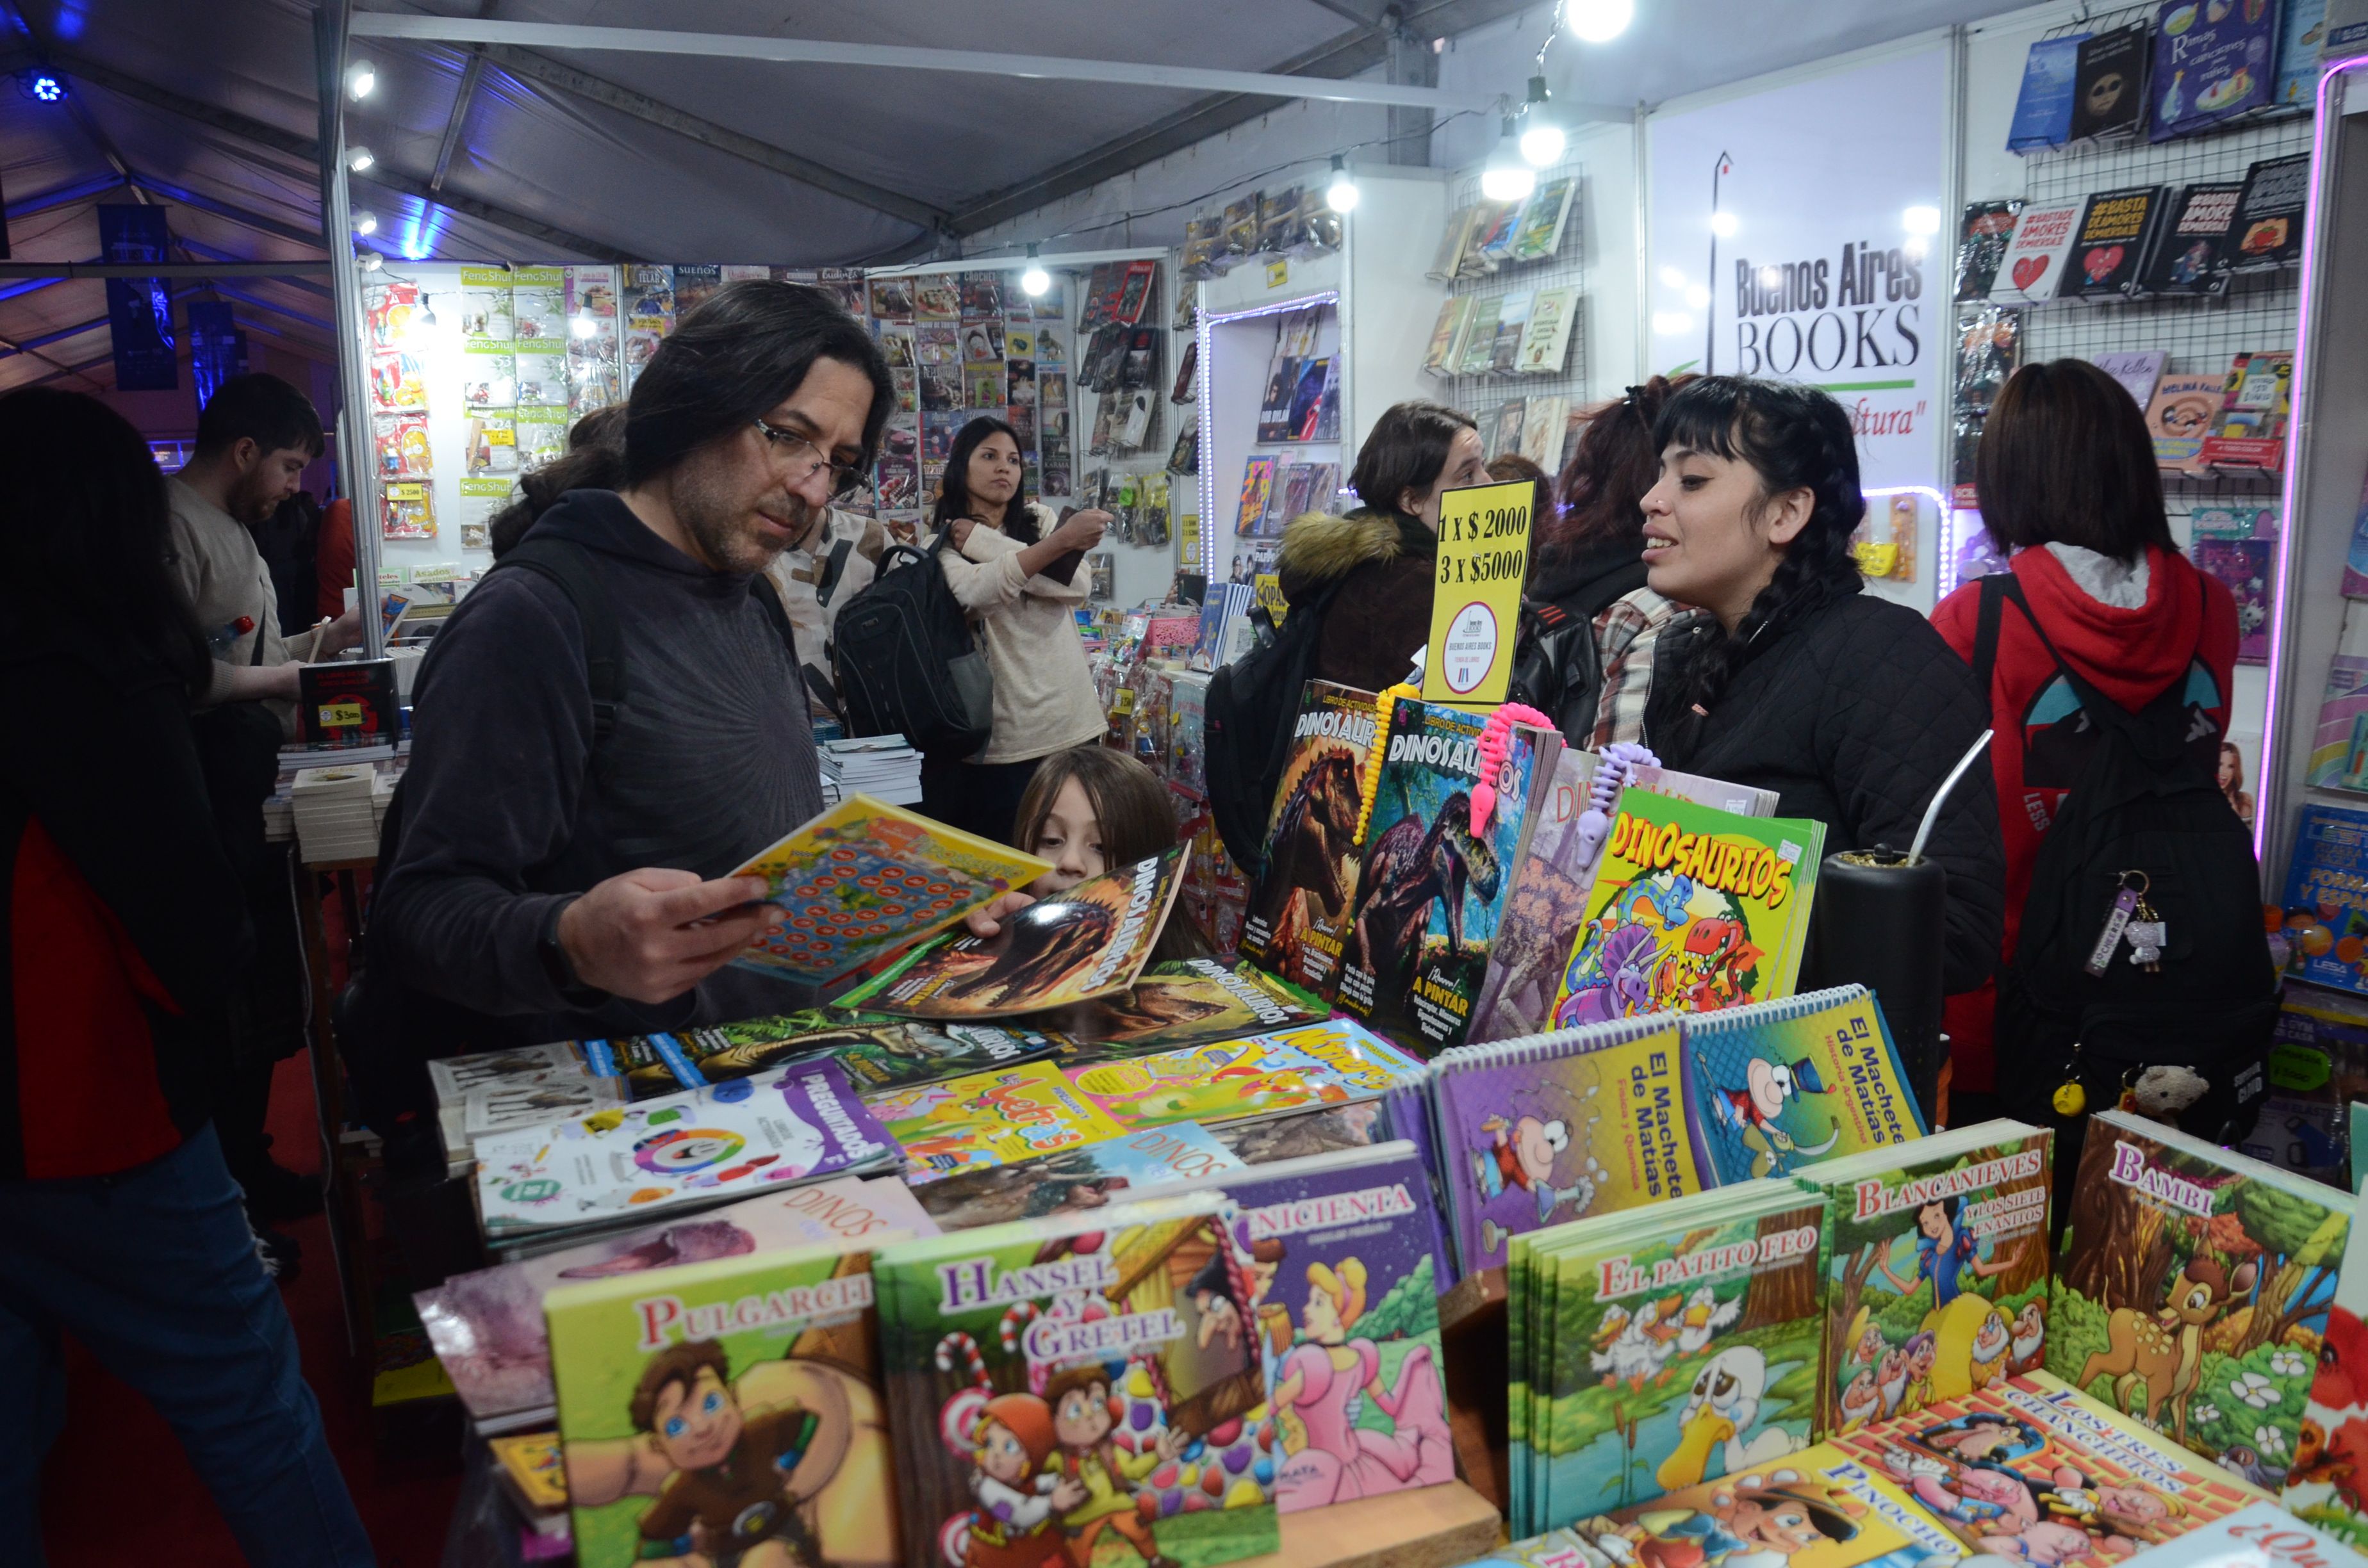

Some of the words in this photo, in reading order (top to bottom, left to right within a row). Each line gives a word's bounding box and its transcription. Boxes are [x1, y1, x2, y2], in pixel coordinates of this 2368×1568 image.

[2020, 222, 2071, 238] AMORES
[463, 271, 488, 281] Feng
[489, 271, 511, 281] Shui
[514, 272, 539, 281] Feng
[540, 272, 563, 281] Shui
[678, 265, 717, 275] SUEÑOS
[964, 272, 996, 282] CROCHET
[1736, 257, 1829, 318] Buenos
[1838, 241, 1921, 306] Aires
[518, 340, 542, 348] Feng
[543, 340, 564, 348] Shui
[1738, 304, 1920, 375] BOOKS
[463, 482, 486, 491] Feng
[1439, 514, 1447, 543] 1
[1453, 516, 1463, 543] x
[1468, 511, 1479, 543] $
[1484, 505, 1527, 539] 2000
[1440, 555, 1451, 584] 3
[1456, 558, 1466, 584] x
[2023, 792, 2051, 831] LESS
[1609, 811, 1793, 910] DINOSAURIOS
[1080, 856, 1158, 993] DINOSAURIOS
[1299, 927, 1308, 942] A
[1310, 930, 1344, 958] PINTAR
[1187, 958, 1290, 1025] DINOSAURIOS
[1413, 976, 1422, 993] A
[1424, 980, 1468, 1017] PINTAR
[1631, 1065, 1649, 1097] de
[1649, 1050, 1668, 1077] El
[1836, 1028, 1854, 1057] de
[1848, 1064, 1886, 1143] Matías
[1849, 1016, 1871, 1040] El
[1860, 1045, 1905, 1145] Machete
[1825, 1034, 1846, 1082] Historia
[1842, 1084, 1868, 1145] Argentina
[1128, 1132, 1231, 1180] DINOS
[1636, 1106, 1662, 1197] Matías
[1653, 1085, 1683, 1199] Machete
[1855, 1149, 2041, 1221] BLANCANIEVES
[1965, 1205, 1978, 1220] Y
[1978, 1198, 2004, 1216] LOS
[2005, 1186, 2045, 1211] SIETE
[2112, 1143, 2214, 1216] BAMBI
[783, 1188, 889, 1239] DINOS
[1974, 1205, 2044, 1237] ENANITOS
[941, 1257, 1117, 1311] HANSEL
[1596, 1255, 1650, 1302] EL
[1655, 1241, 1757, 1286] PATITO
[1761, 1227, 1816, 1261] FEO
[1049, 1294, 1087, 1320] Y
[1024, 1309, 1185, 1362] GRETEL
[2004, 1389, 2186, 1493] CHANCHITOS
[2043, 1389, 2109, 1433] LOS
[2112, 1429, 2187, 1473] TRES
[1820, 1458, 1962, 1556] PINOCHO
